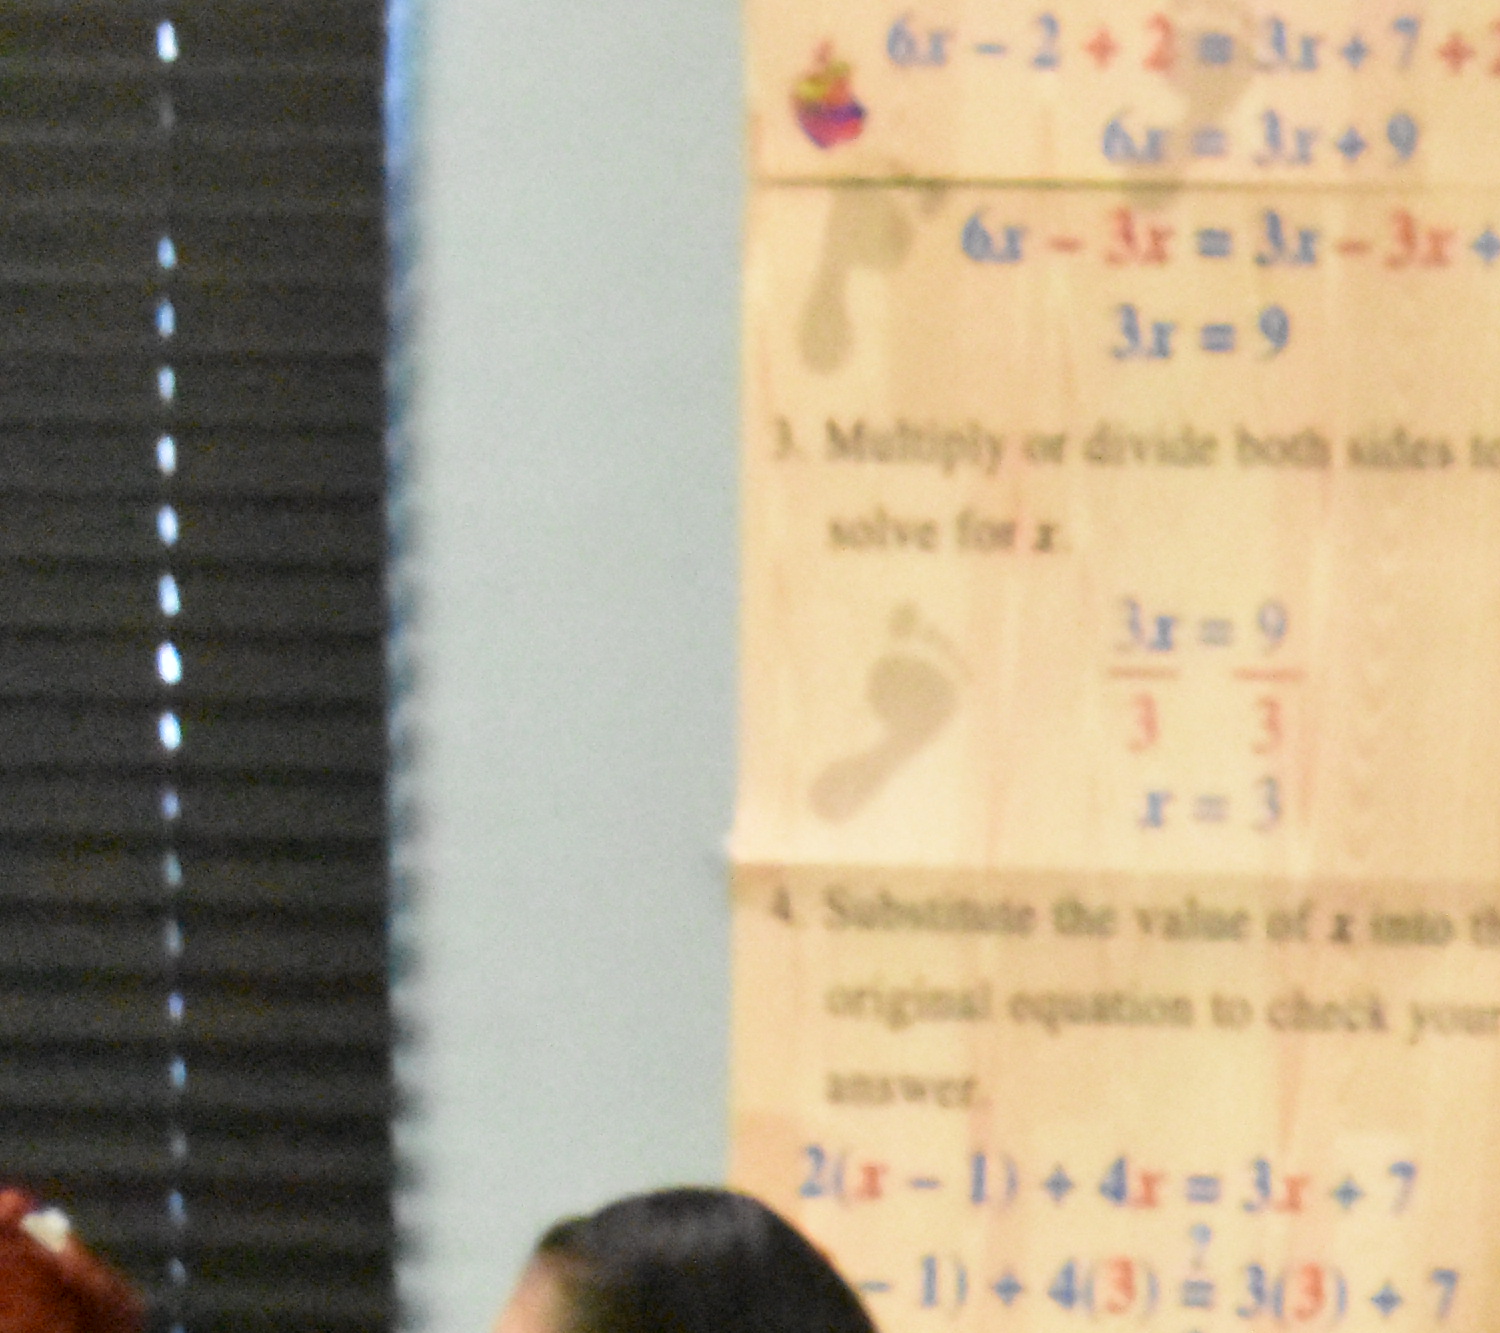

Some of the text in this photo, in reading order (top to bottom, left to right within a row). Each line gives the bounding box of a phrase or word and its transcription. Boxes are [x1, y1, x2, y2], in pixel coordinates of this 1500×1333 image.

[1083, 422, 1220, 466] divide
[1236, 423, 1331, 468] both
[1347, 425, 1455, 469] sides
[829, 511, 936, 551] solve
[822, 890, 1038, 938] Substitute
[1135, 899, 1246, 943] value
[1009, 991, 1193, 1038] equation
[1268, 994, 1386, 1034] check
